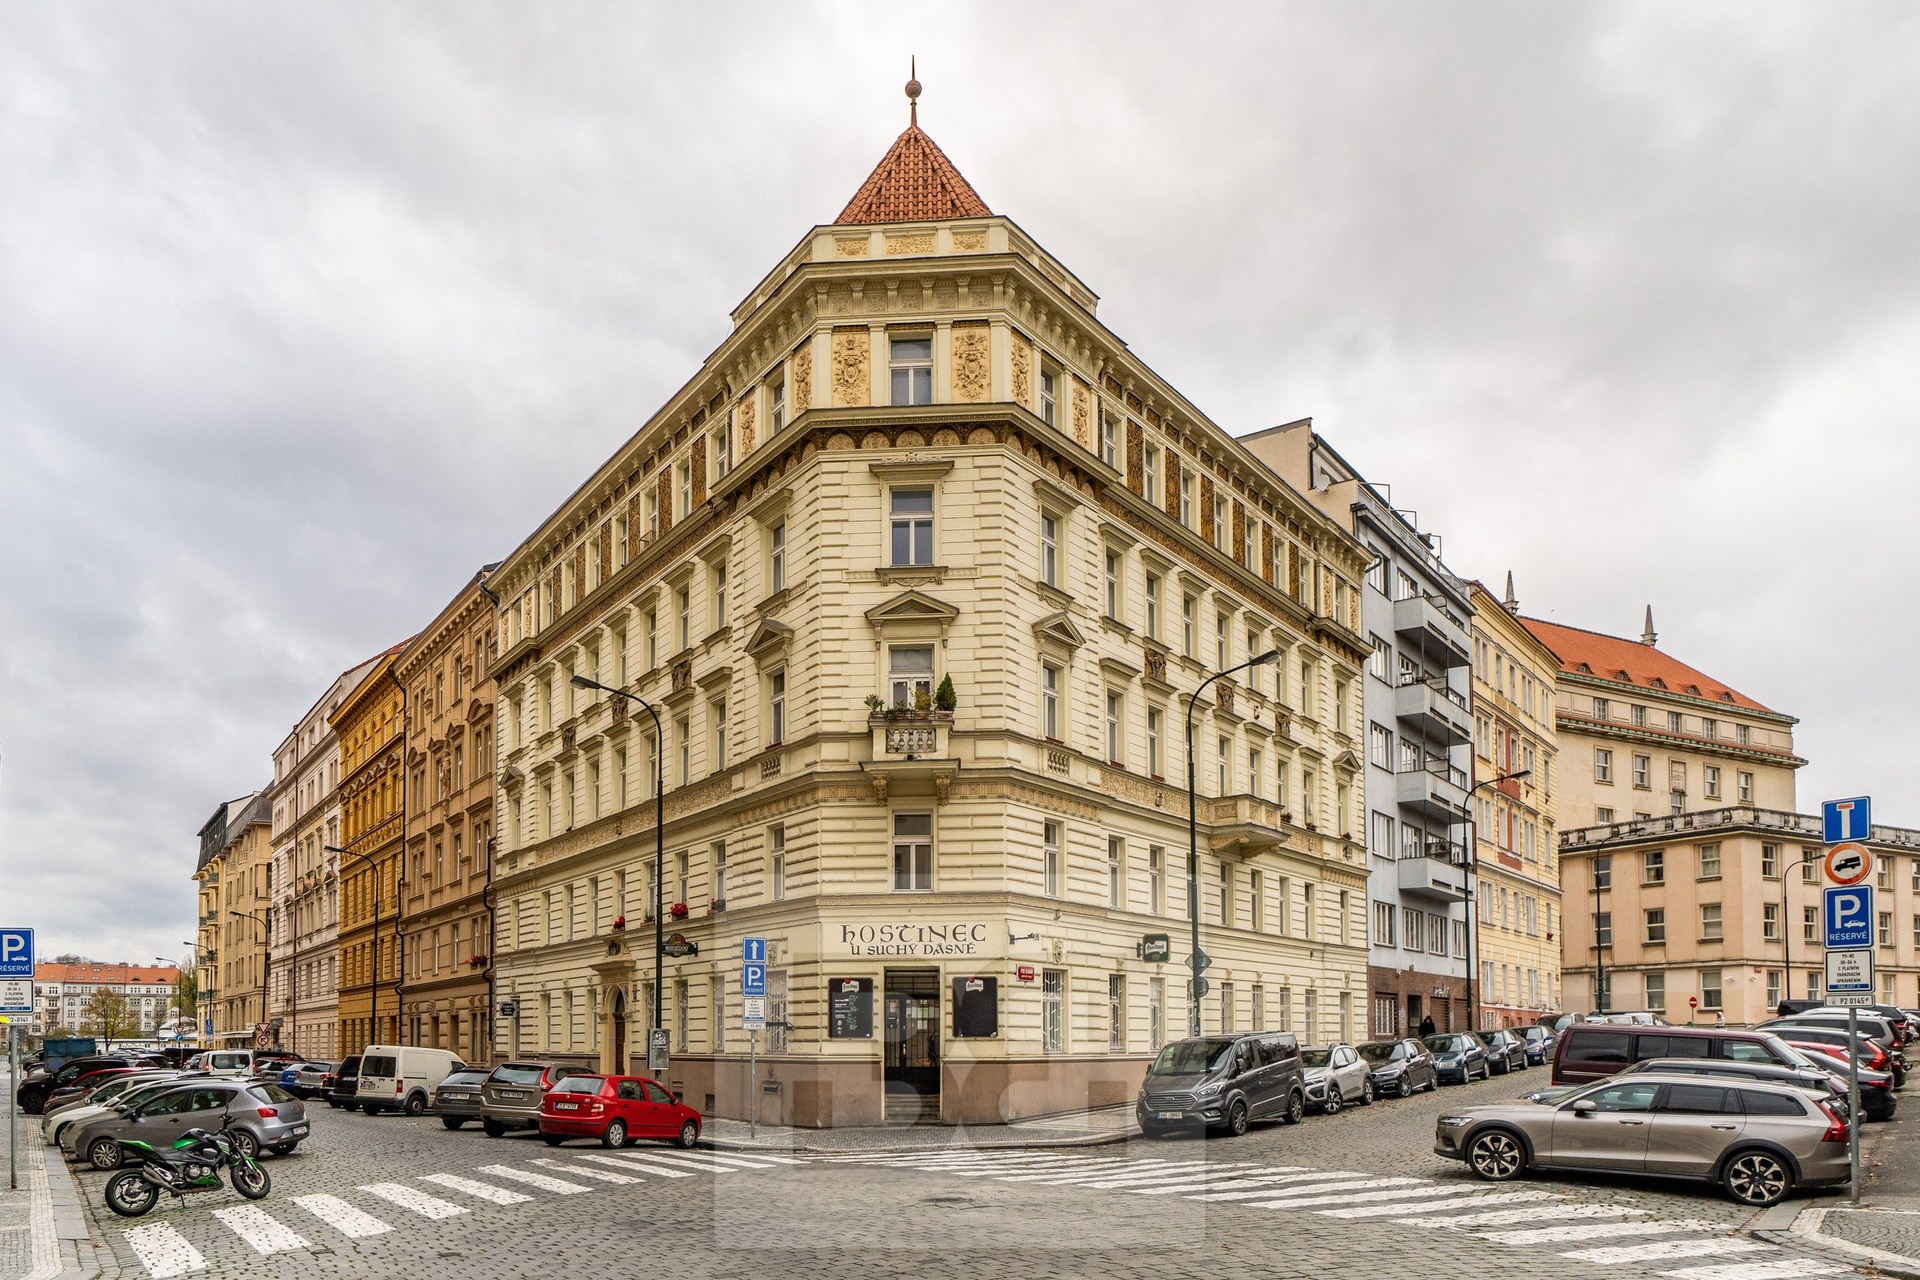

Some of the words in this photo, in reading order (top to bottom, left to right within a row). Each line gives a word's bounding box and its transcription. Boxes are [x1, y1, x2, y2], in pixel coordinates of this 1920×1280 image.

[1835, 895, 1860, 929] P
[1830, 931, 1867, 940] RÉSERVÉ
[3, 935, 25, 961] P
[748, 967, 761, 986] P
